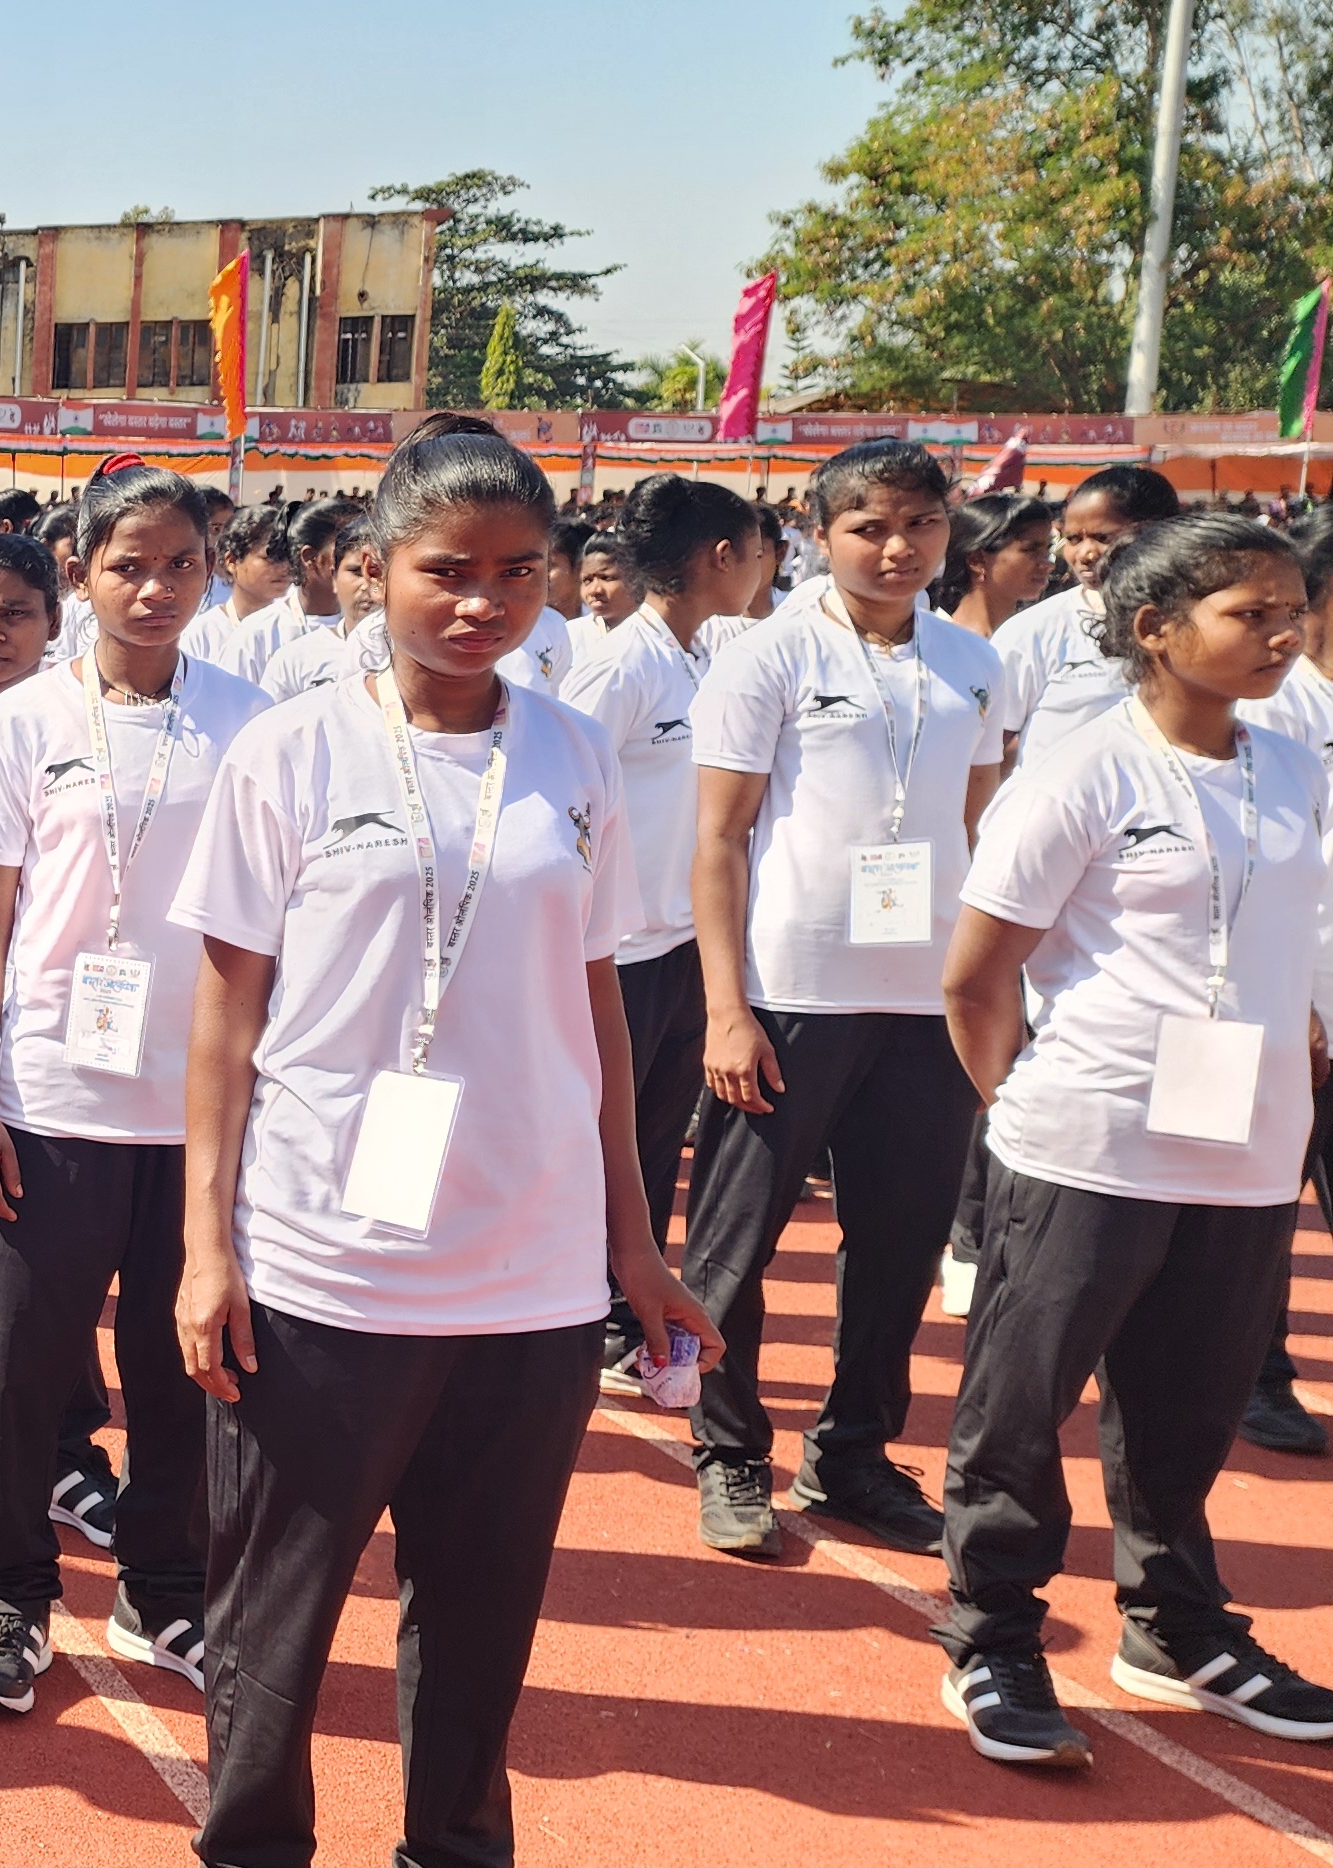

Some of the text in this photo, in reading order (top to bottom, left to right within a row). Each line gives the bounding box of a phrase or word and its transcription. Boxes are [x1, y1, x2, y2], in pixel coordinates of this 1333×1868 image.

[44, 777, 96, 798] SHIV-NARES
[144, 798, 155, 815] 2025
[324, 837, 408, 859] SHIV-NARESH
[423, 866, 435, 949] बस्तर ओलंपिक 2025
[446, 869, 480, 948] बस्तर ओलंपिक 2025
